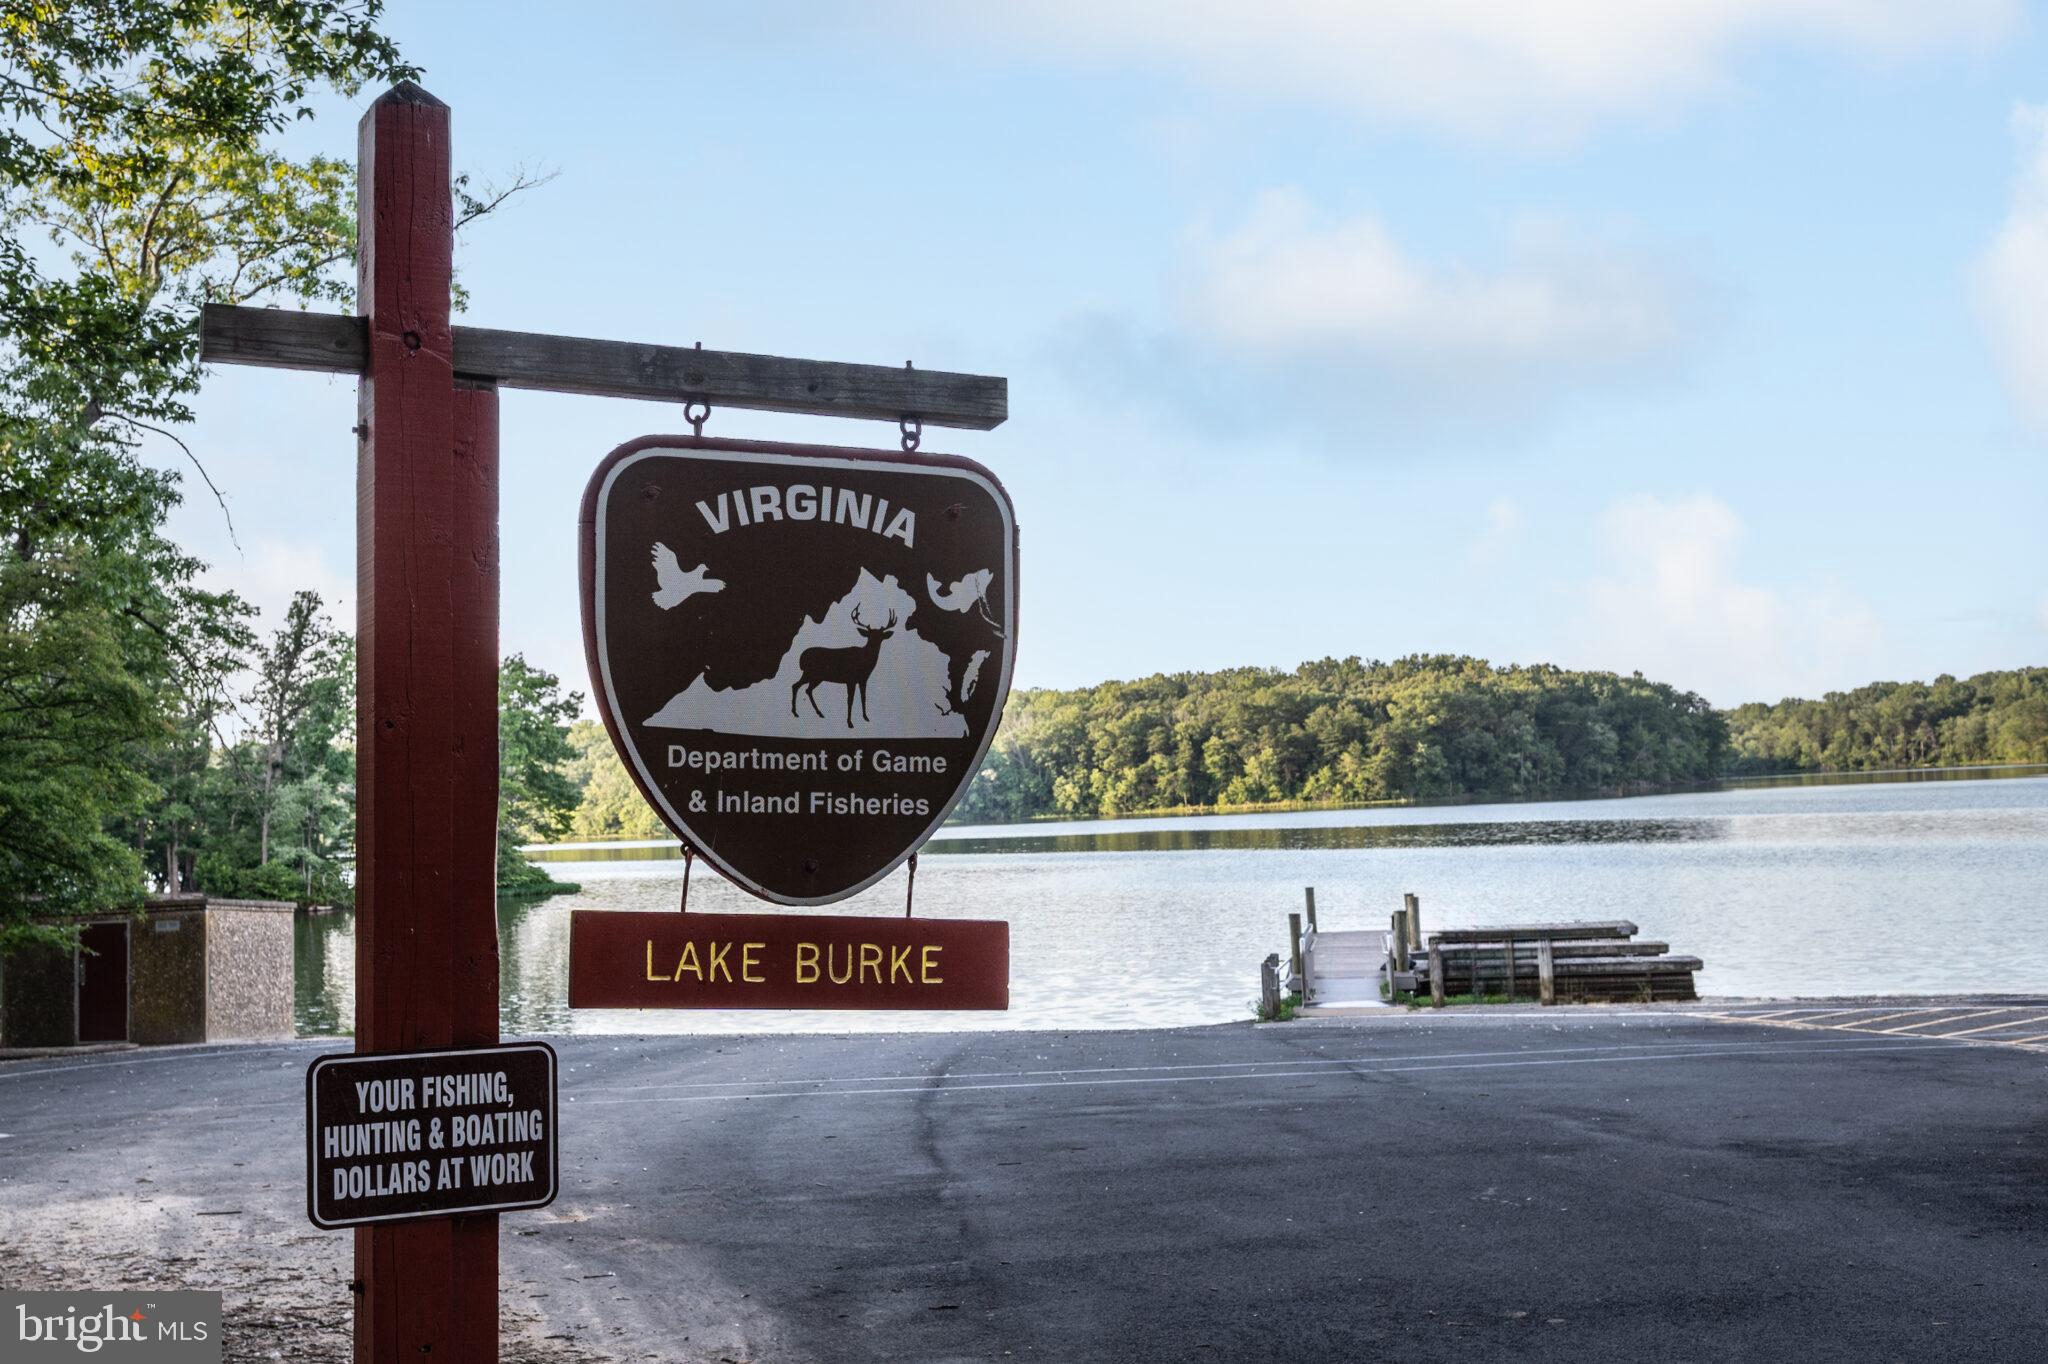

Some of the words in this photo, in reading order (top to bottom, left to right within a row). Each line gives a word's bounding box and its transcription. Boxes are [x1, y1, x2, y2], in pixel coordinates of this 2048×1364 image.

[696, 484, 917, 549] VIRGINIA
[667, 745, 829, 774] Department
[837, 751, 864, 772] of
[871, 749, 947, 774] Game
[688, 790, 708, 814] &
[717, 789, 800, 815] Inland
[810, 791, 930, 816] Fisheries
[646, 939, 766, 983] LAKE
[796, 942, 944, 985] BURKE
[355, 1077, 415, 1114] YOUR
[422, 1071, 514, 1109] FISHING,
[324, 1118, 421, 1159] HUNTING
[429, 1115, 445, 1152] &
[451, 1109, 543, 1149] BOATING
[333, 1161, 430, 1201] DOLLARS
[437, 1158, 463, 1191] AT
[470, 1150, 535, 1187] WORK
